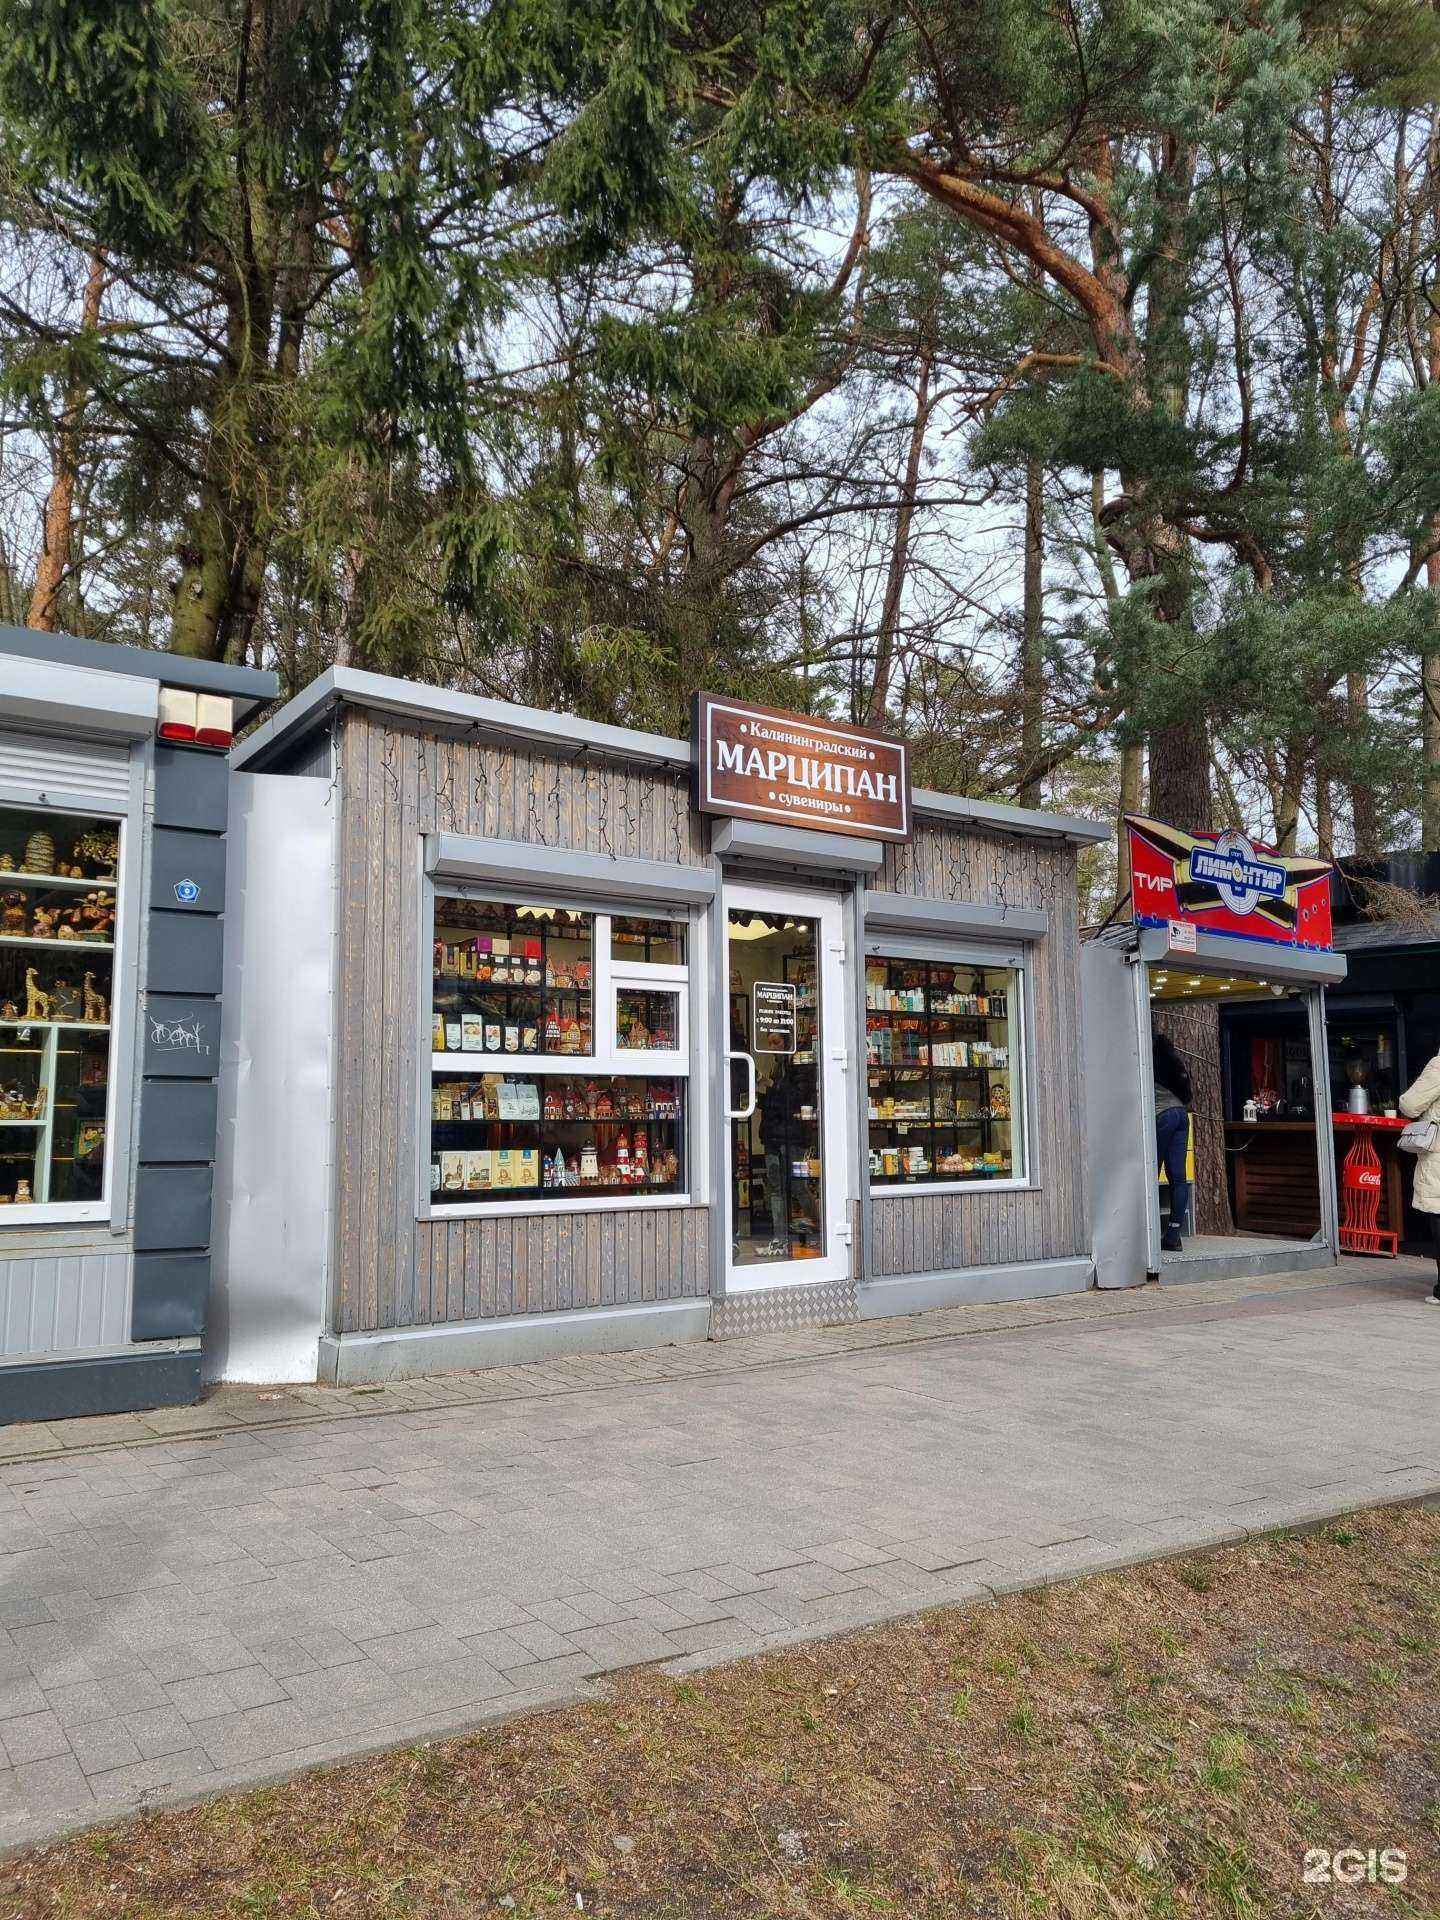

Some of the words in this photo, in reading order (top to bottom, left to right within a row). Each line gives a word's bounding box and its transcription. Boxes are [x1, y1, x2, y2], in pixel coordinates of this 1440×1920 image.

[749, 721, 868, 761] Калининградский
[716, 740, 898, 803] МАРЦИПАН
[778, 792, 844, 813] сувениры
[1134, 871, 1173, 893] ТИР
[757, 991, 793, 1000] МАРЦИПАН
